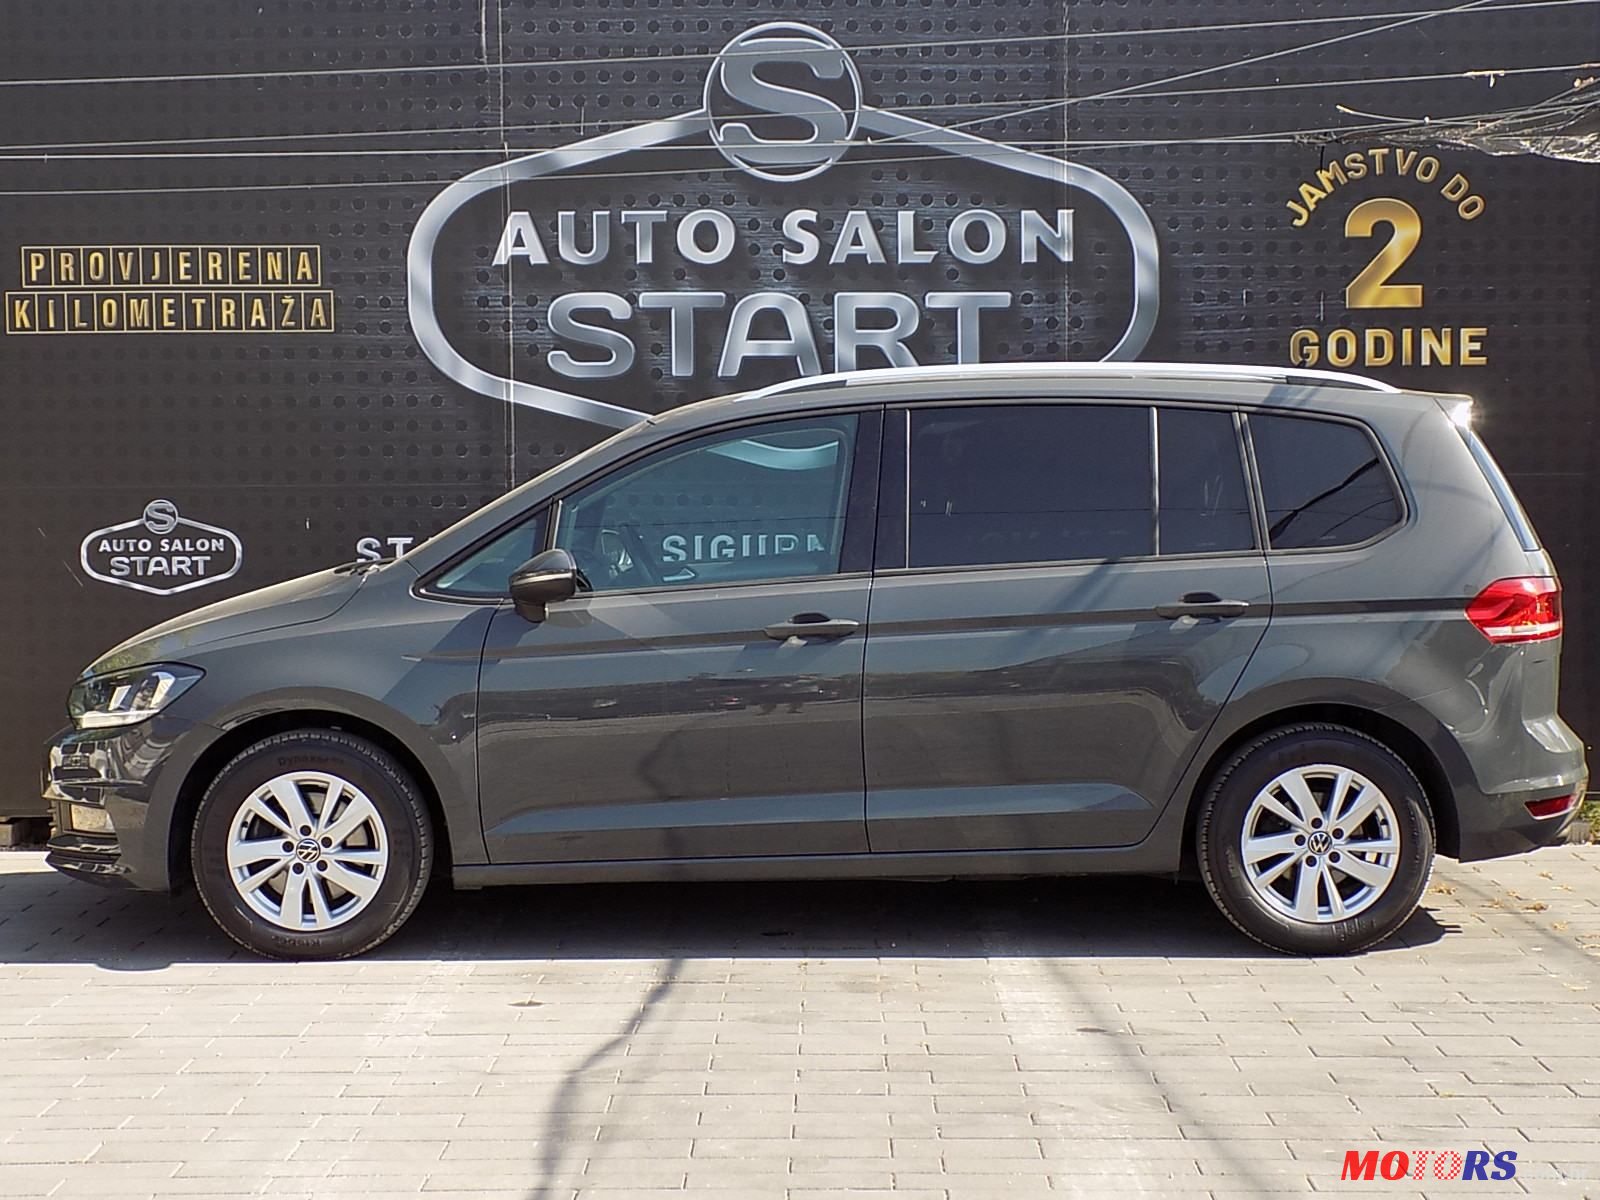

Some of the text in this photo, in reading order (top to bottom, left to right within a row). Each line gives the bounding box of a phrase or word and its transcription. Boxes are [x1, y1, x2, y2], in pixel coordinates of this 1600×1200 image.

[720, 37, 852, 166] S
[1286, 148, 1485, 227] JAMSTVO DO
[492, 208, 1075, 266] AUTO SALON
[1345, 197, 1423, 309] 2
[30, 251, 313, 282] PROVJERENA
[15, 295, 327, 329] KILOMETRAŽA
[547, 291, 1012, 379] START
[1289, 327, 1489, 368] GODINE
[146, 502, 175, 531] S
[99, 538, 225, 552] AUTO SALON
[357, 537, 433, 562] ST
[110, 556, 211, 576] START
